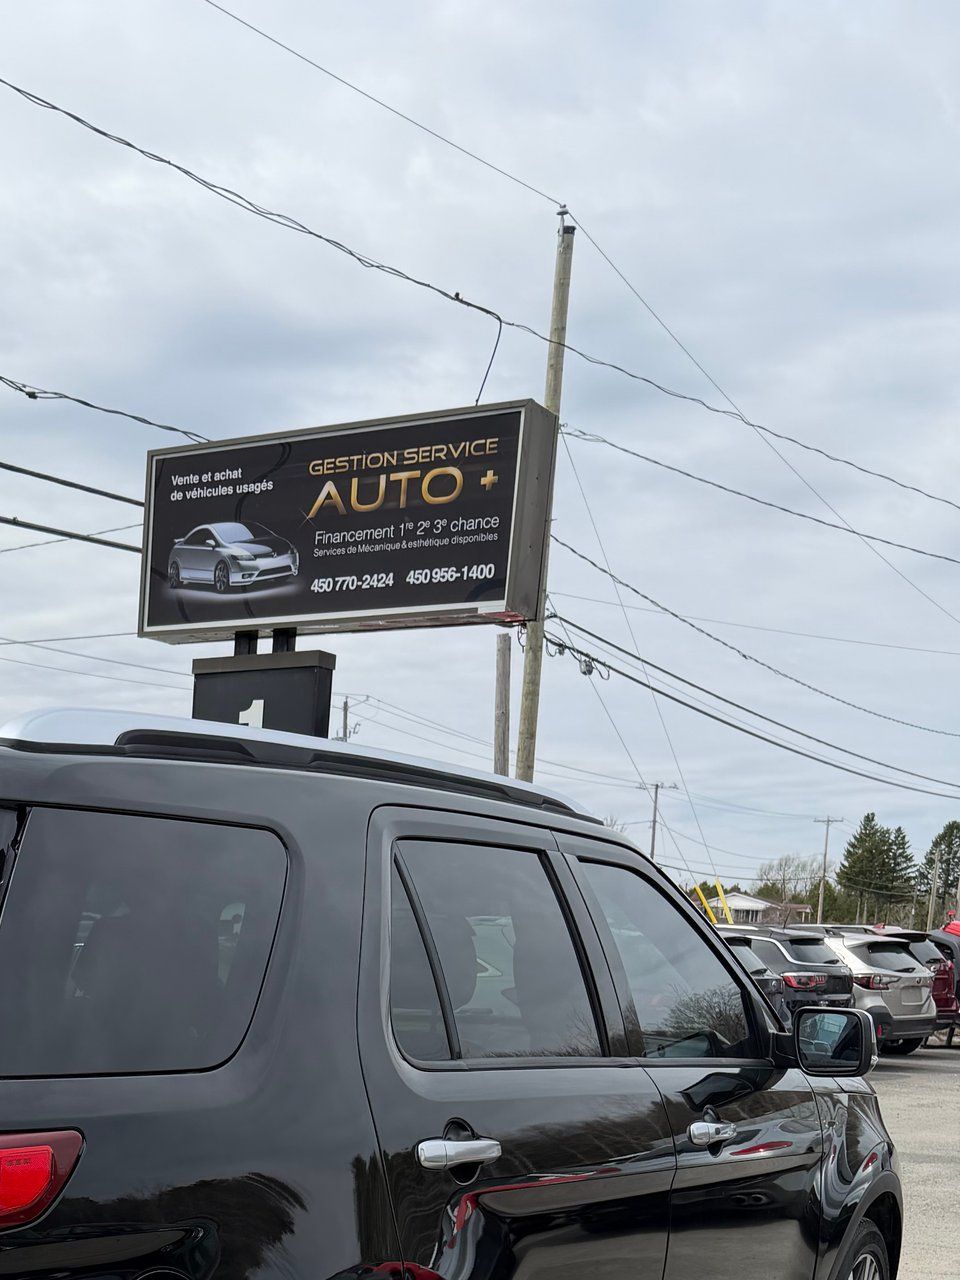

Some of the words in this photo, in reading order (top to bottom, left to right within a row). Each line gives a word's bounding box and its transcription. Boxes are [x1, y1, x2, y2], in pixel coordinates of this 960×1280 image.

[309, 451, 397, 475] GESTION
[403, 437, 499, 465] SERVICE
[171, 474, 200, 486] Vente
[201, 471, 212, 483] et
[214, 467, 243, 481] achat
[170, 490, 183, 502] de
[185, 485, 234, 500] véhicules
[235, 479, 274, 494] usagés
[306, 466, 464, 519] AUTO
[315, 524, 395, 545] Financement
[450, 516, 500, 532] chance
[313, 547, 346, 558] Services
[346, 545, 357, 554] de
[357, 541, 401, 553] Mécanique
[408, 536, 450, 548] esthétique
[451, 532, 499, 545] disponibles
[310, 578, 334, 593] 450
[335, 572, 394, 591] 770-2424
[406, 568, 431, 585] 450
[431, 563, 496, 583] 956-1400
